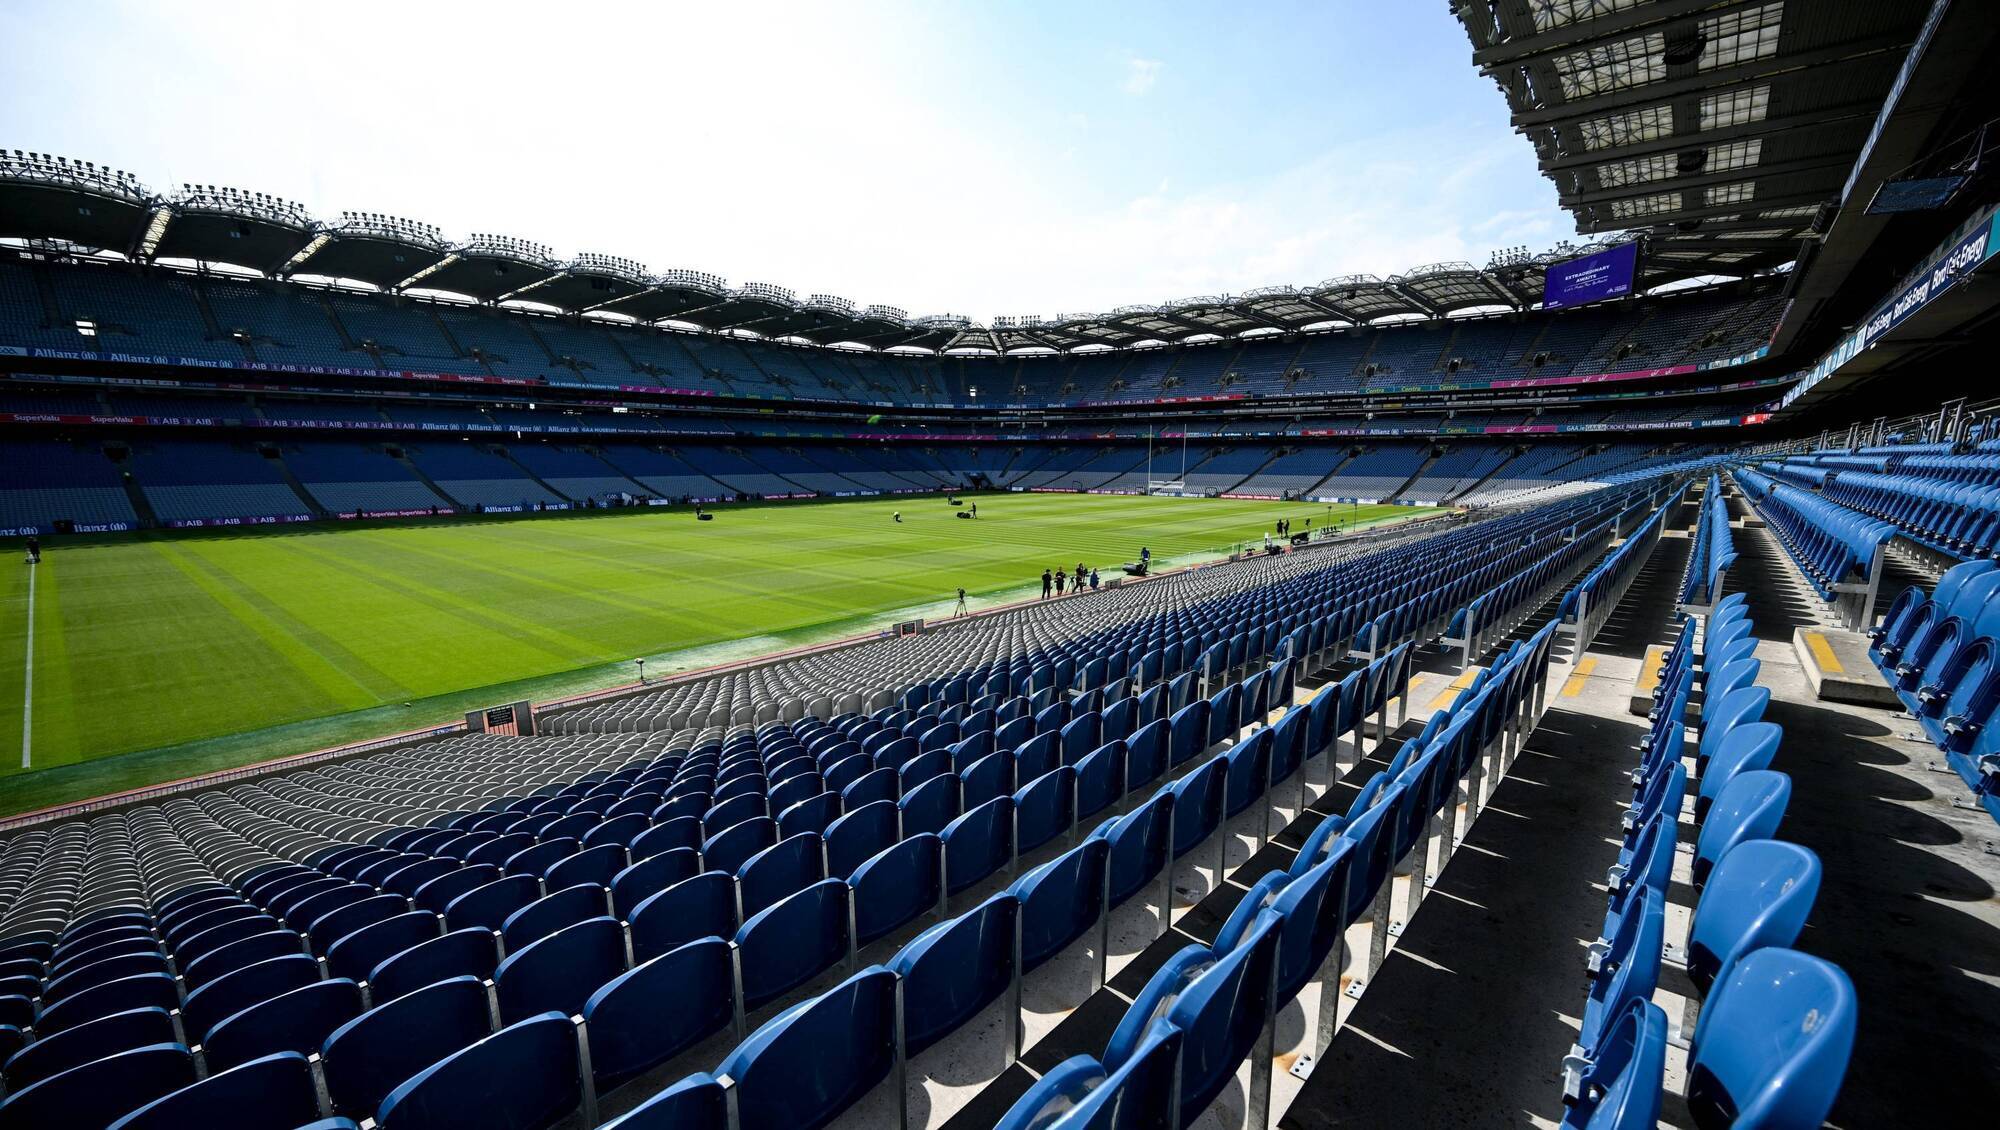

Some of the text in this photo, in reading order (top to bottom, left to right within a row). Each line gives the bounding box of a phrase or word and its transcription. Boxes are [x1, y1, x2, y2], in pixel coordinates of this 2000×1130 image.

[1960, 232, 1988, 268] Energy
[1565, 265, 1610, 280] EXTRAORDINARY
[1576, 274, 1596, 283] AWAITS
[34, 348, 80, 360] Allianz
[110, 353, 151, 364] Allianz
[180, 358, 218, 368] Allianz
[14, 414, 60, 422] SuperValu
[74, 524, 108, 532] lianz
